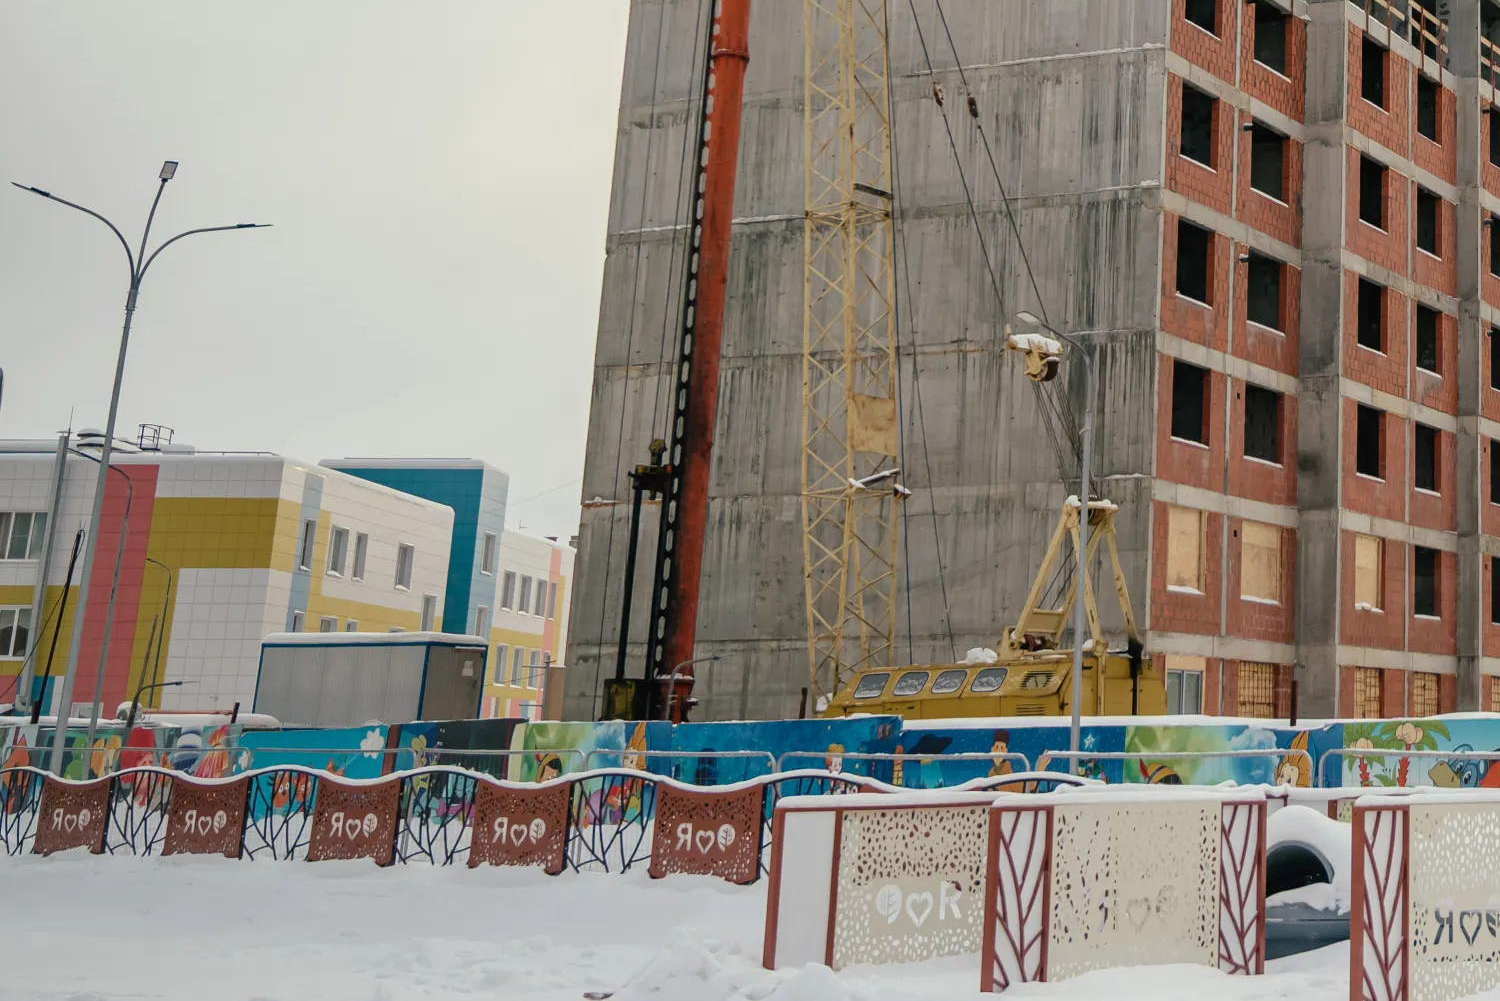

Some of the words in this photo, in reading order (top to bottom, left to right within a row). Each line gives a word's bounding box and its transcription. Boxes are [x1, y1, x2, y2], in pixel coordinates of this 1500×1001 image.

[51, 807, 64, 831] Я
[183, 809, 197, 835] Я
[329, 811, 345, 838] Я
[491, 816, 509, 845] Я
[675, 822, 693, 851] Я
[1433, 896, 1454, 946] Я
